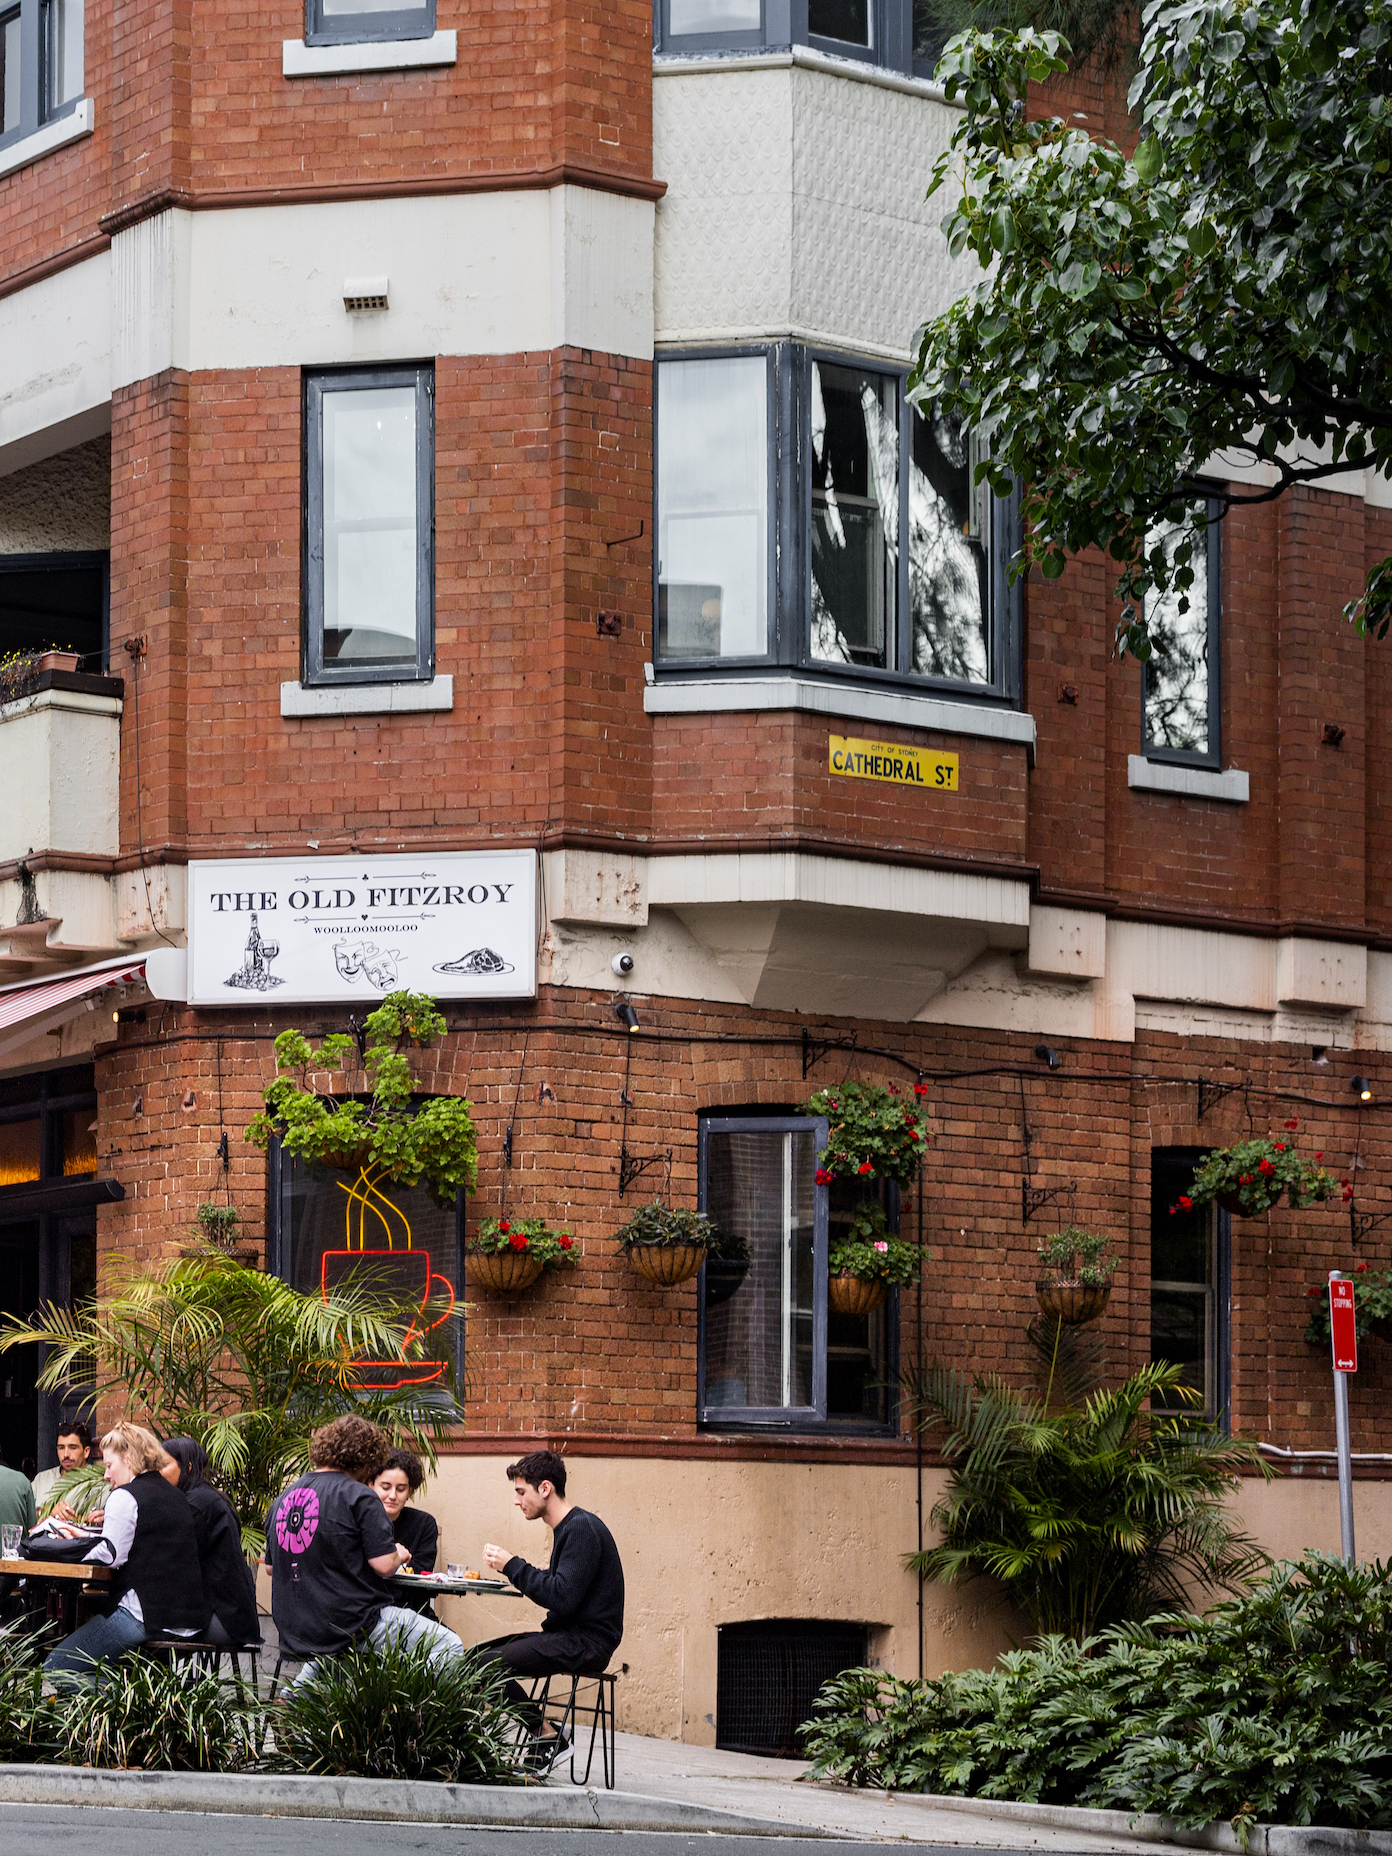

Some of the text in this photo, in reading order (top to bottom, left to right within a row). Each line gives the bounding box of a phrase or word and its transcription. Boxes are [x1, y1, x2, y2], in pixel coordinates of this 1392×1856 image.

[871, 744, 883, 752] CITY
[898, 748, 918, 757] SYDNEY
[832, 750, 924, 782] CATHEDRAL
[210, 883, 515, 912] THE OLD FITZROY
[314, 924, 418, 934] WOOLLOOMOOLOO
[1338, 1286, 1346, 1296] NO
[1333, 1297, 1353, 1309] STOPPING
